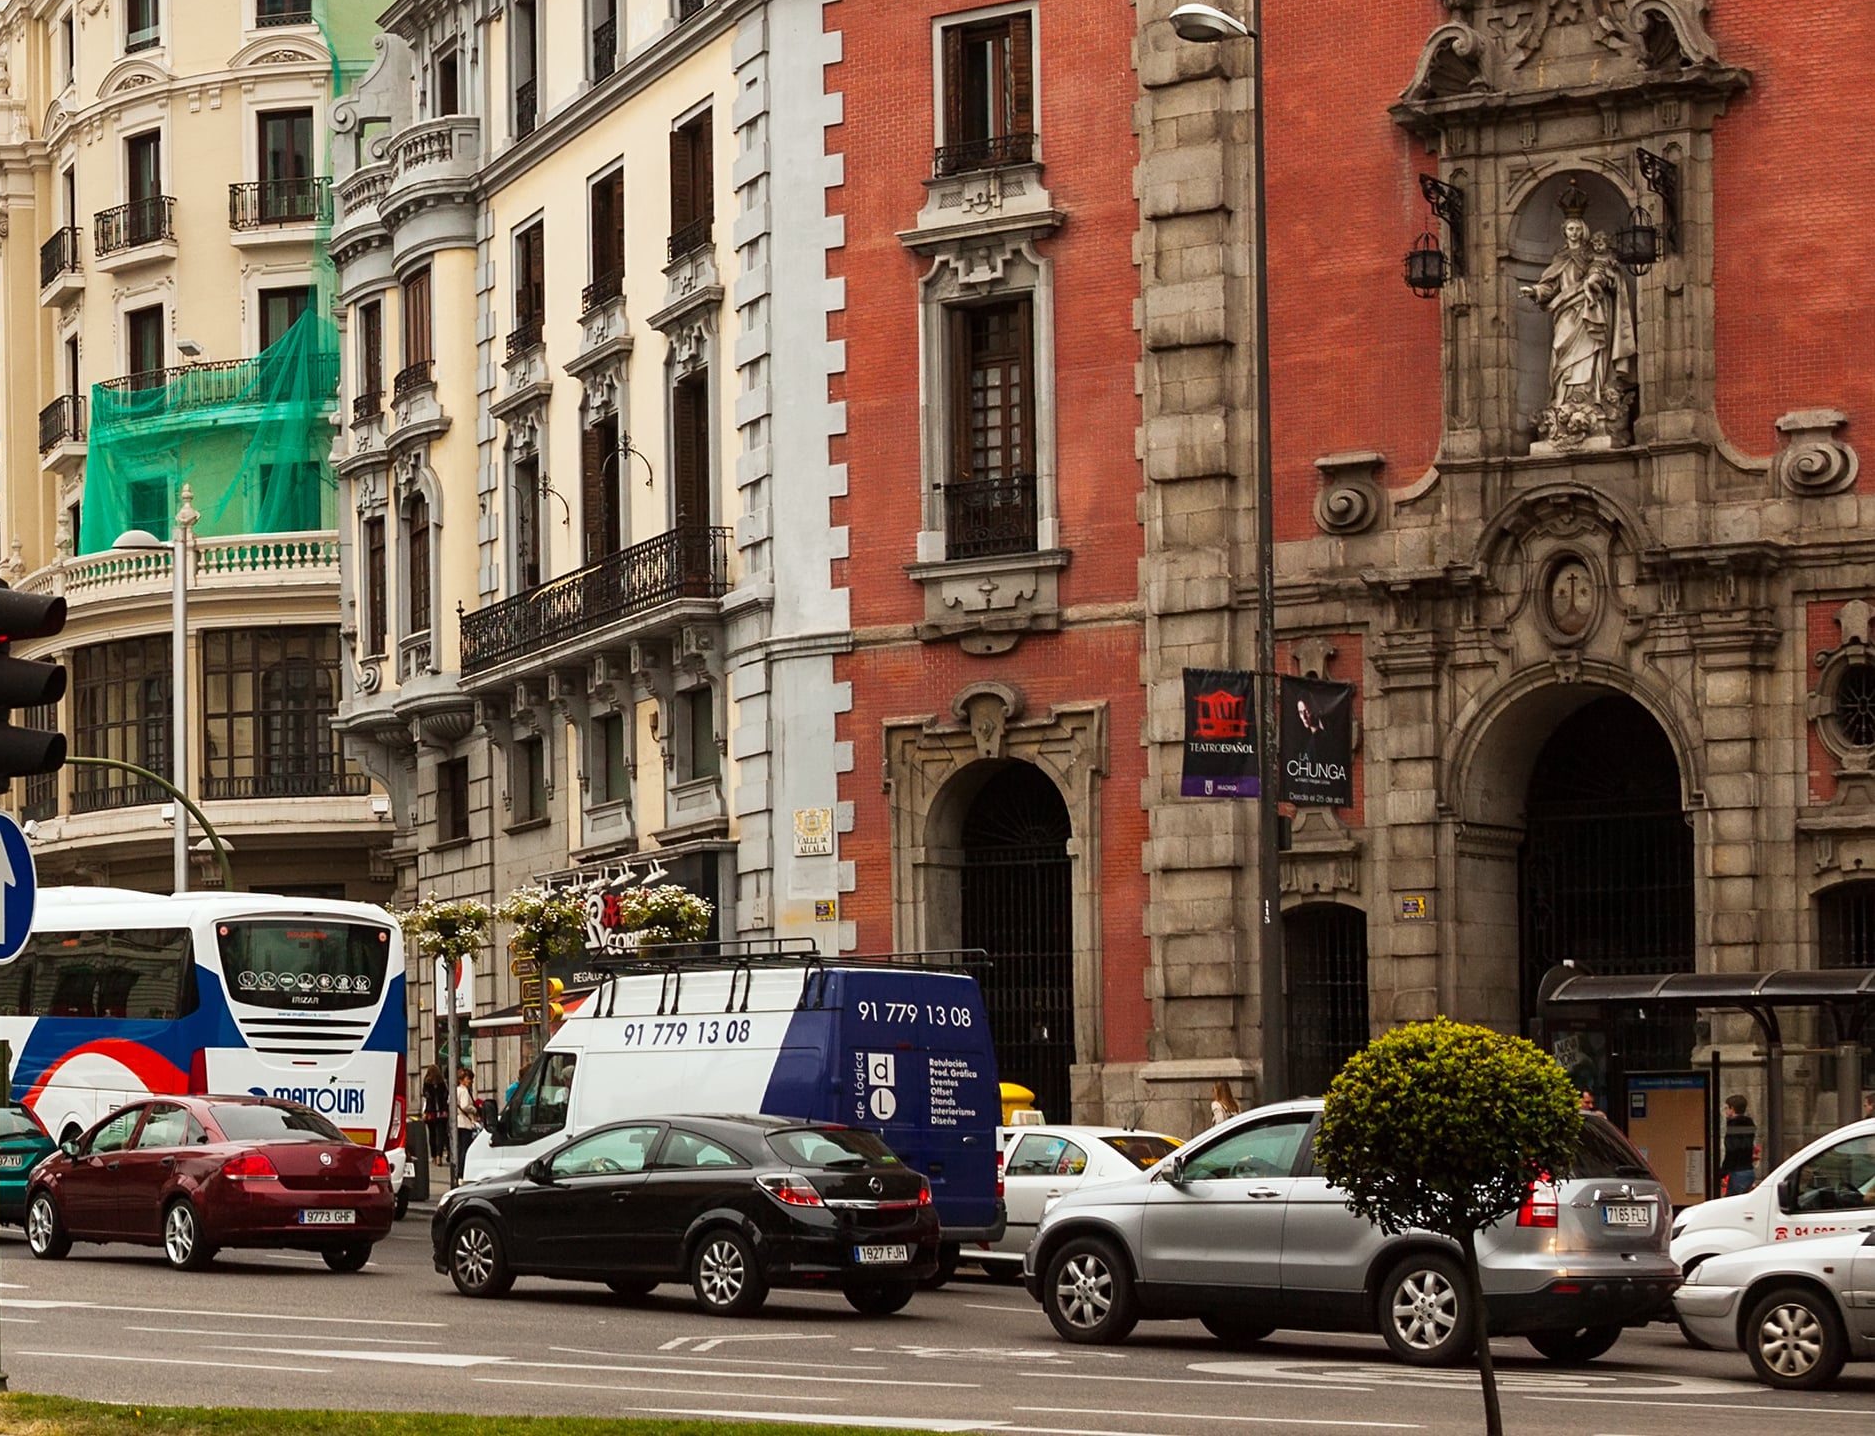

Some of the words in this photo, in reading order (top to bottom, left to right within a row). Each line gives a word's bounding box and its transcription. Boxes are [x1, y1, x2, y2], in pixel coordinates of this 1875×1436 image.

[1190, 742, 1254, 754] TEATROESPAÑOL
[1299, 752, 1309, 761] LA
[1286, 759, 1347, 781] CHUNGA
[1289, 791, 1309, 802] Desde
[1316, 794, 1324, 803] 25
[1325, 795, 1333, 804] de
[292, 995, 320, 1005] IRIZAR
[858, 1001, 878, 1022] 91
[885, 1002, 918, 1023] 779
[926, 1005, 946, 1026] 13
[950, 1006, 972, 1028] 08
[624, 1023, 644, 1046] 91
[652, 1022, 688, 1045] 779
[698, 1021, 720, 1044] 13
[726, 1019, 751, 1043] 08
[929, 1058, 968, 1068] Rotulación
[854, 1052, 866, 1096] Lógica
[930, 1068, 950, 1078] Prod.
[950, 1069, 978, 1079] Gráfica
[930, 1077, 959, 1087] Eventos
[930, 1087, 953, 1096] Offset
[273, 1088, 364, 1114] MAITOURS
[931, 1096, 956, 1106] Stands
[855, 1102, 866, 1120] de
[931, 1106, 976, 1117] Interiorismo
[931, 1116, 957, 1125] Diseño
[306, 1210, 331, 1222] 9773
[334, 1210, 352, 1222] GHF
[1607, 1207, 1629, 1222] 7165
[1631, 1207, 1648, 1222] FLZ
[863, 1247, 884, 1261] 1927
[887, 1246, 905, 1259] FJH
